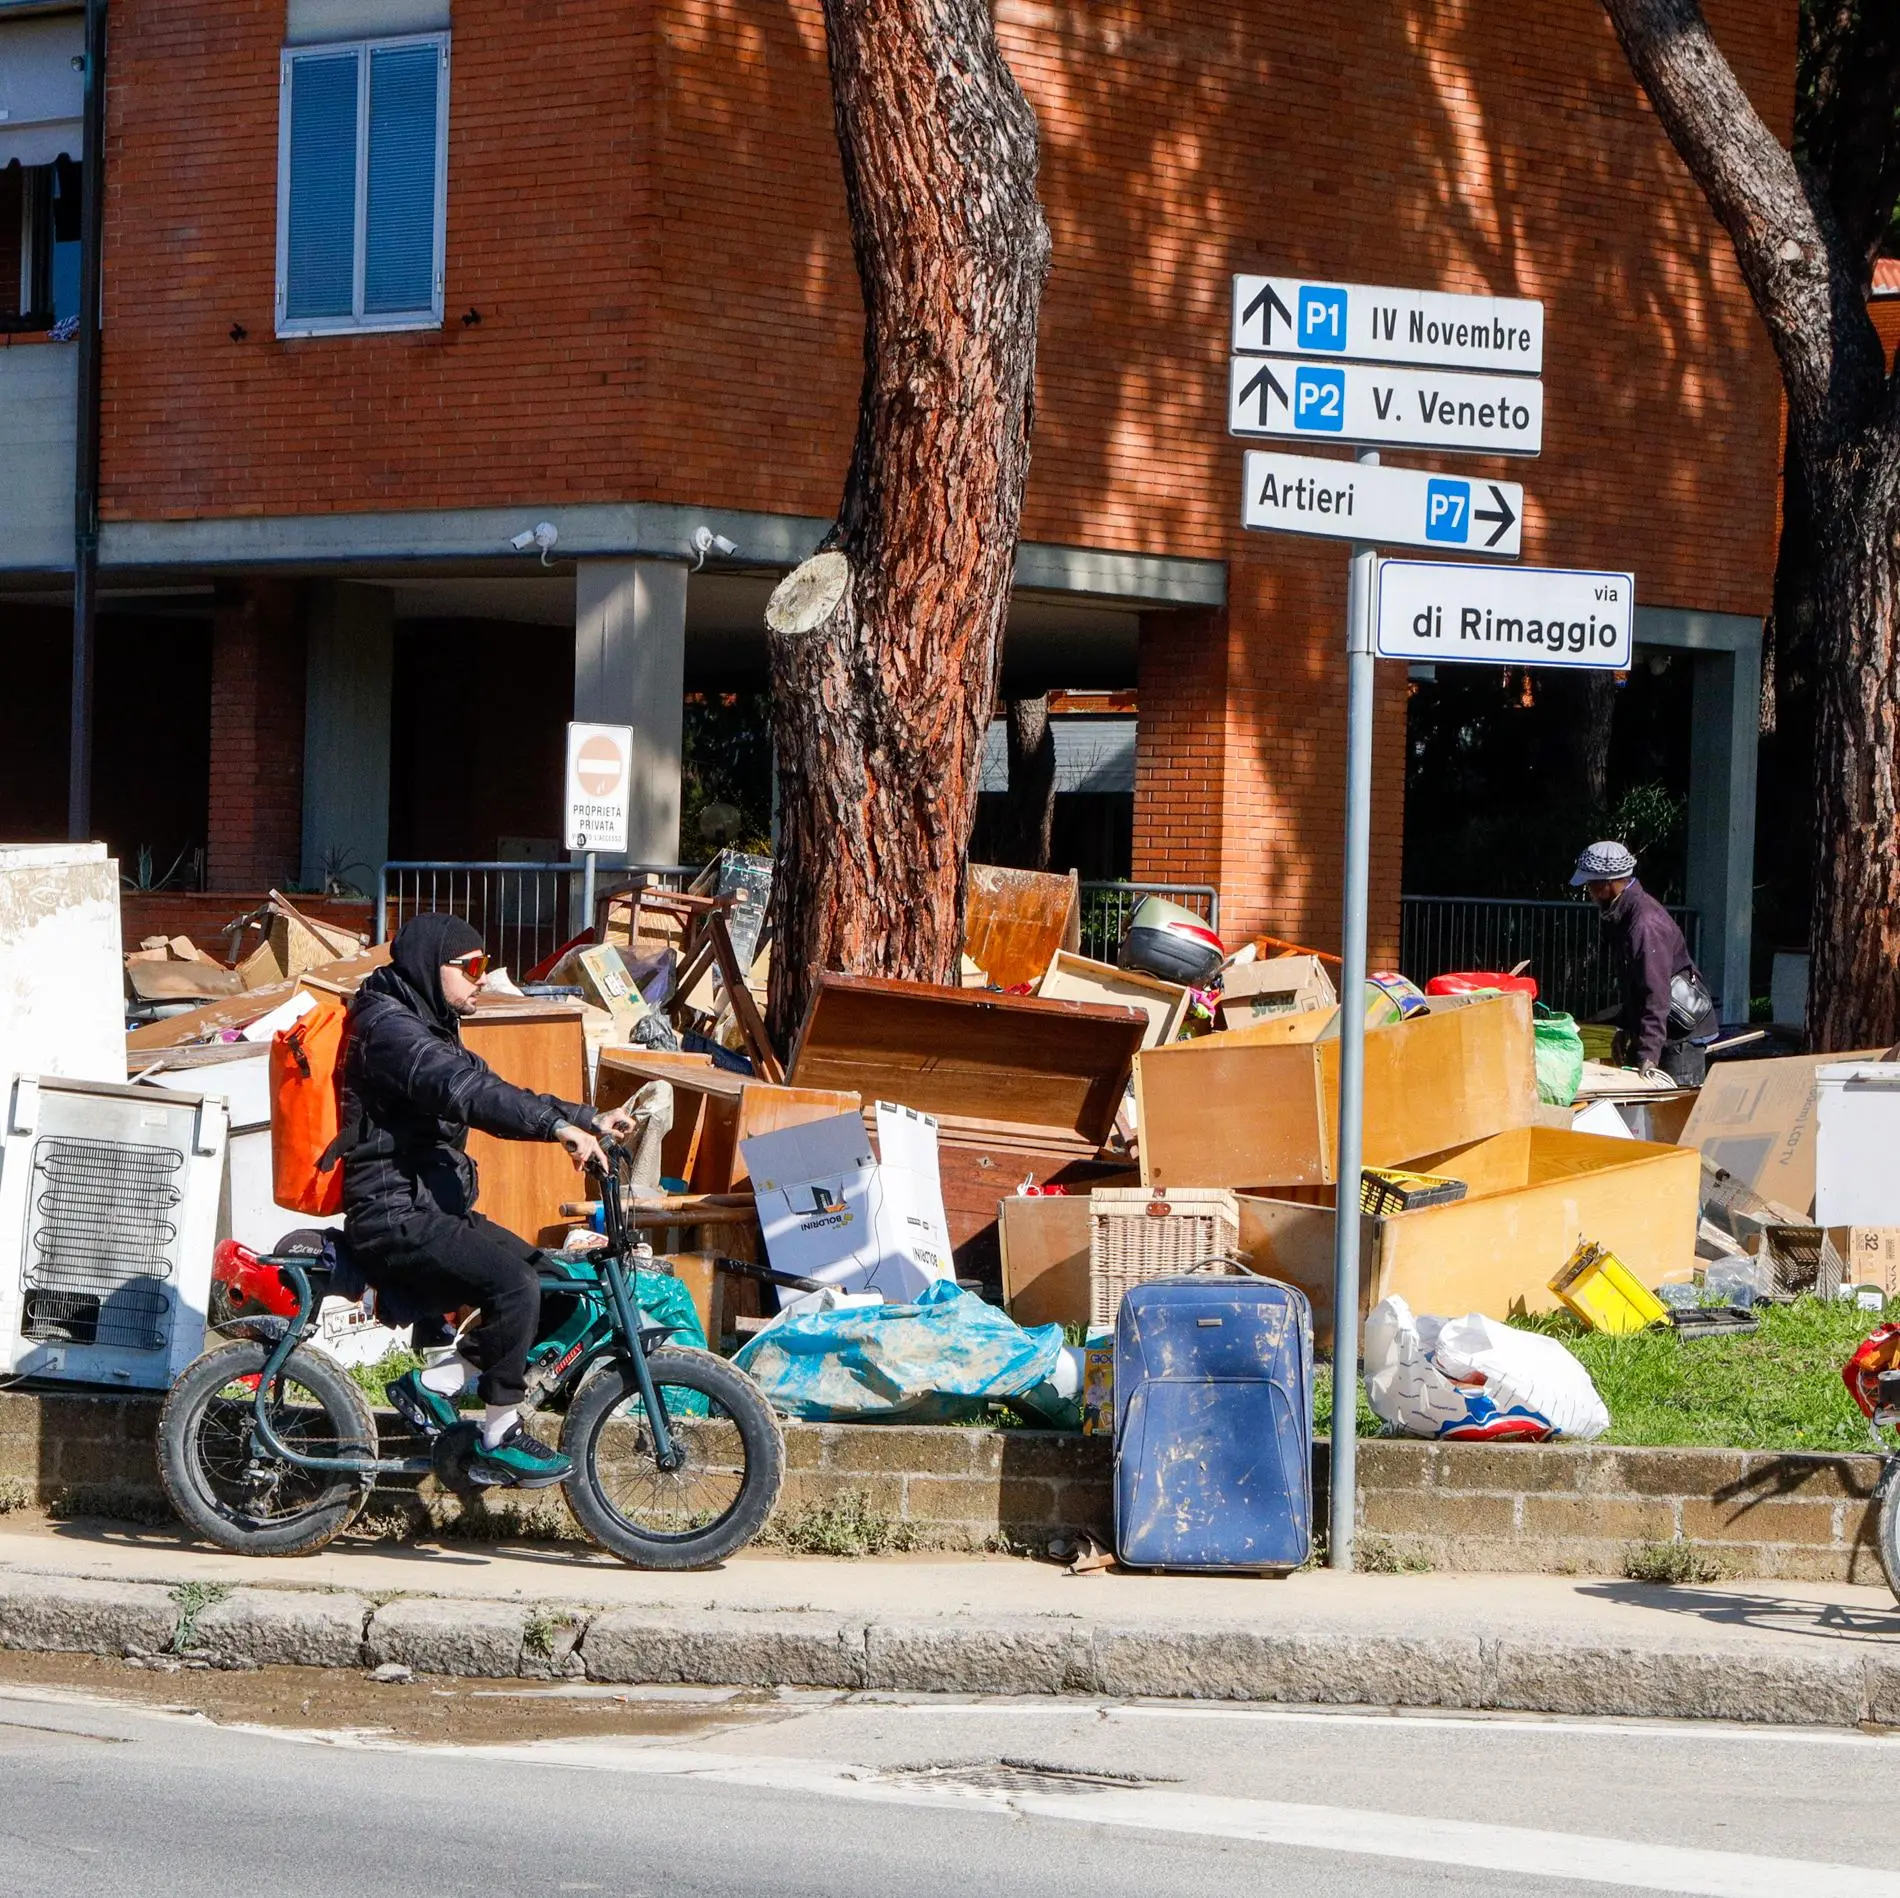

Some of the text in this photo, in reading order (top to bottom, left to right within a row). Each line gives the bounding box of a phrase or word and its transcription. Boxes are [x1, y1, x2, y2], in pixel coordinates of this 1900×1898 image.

[1306, 305, 1531, 352] P1 IV Novembre
[1298, 382, 1530, 431] P2 V. Veneto
[1258, 473, 1465, 528] Artieri P7
[1594, 585, 1618, 602] via
[1412, 605, 1618, 652] di Rimaggio
[580, 819, 614, 831] PRIVATA
[1787, 1125, 1805, 1147] LCD
[1779, 1149, 1795, 1166] TV
[801, 1215, 842, 1231] BOLDRINI
[1864, 1233, 1879, 1251] 32
